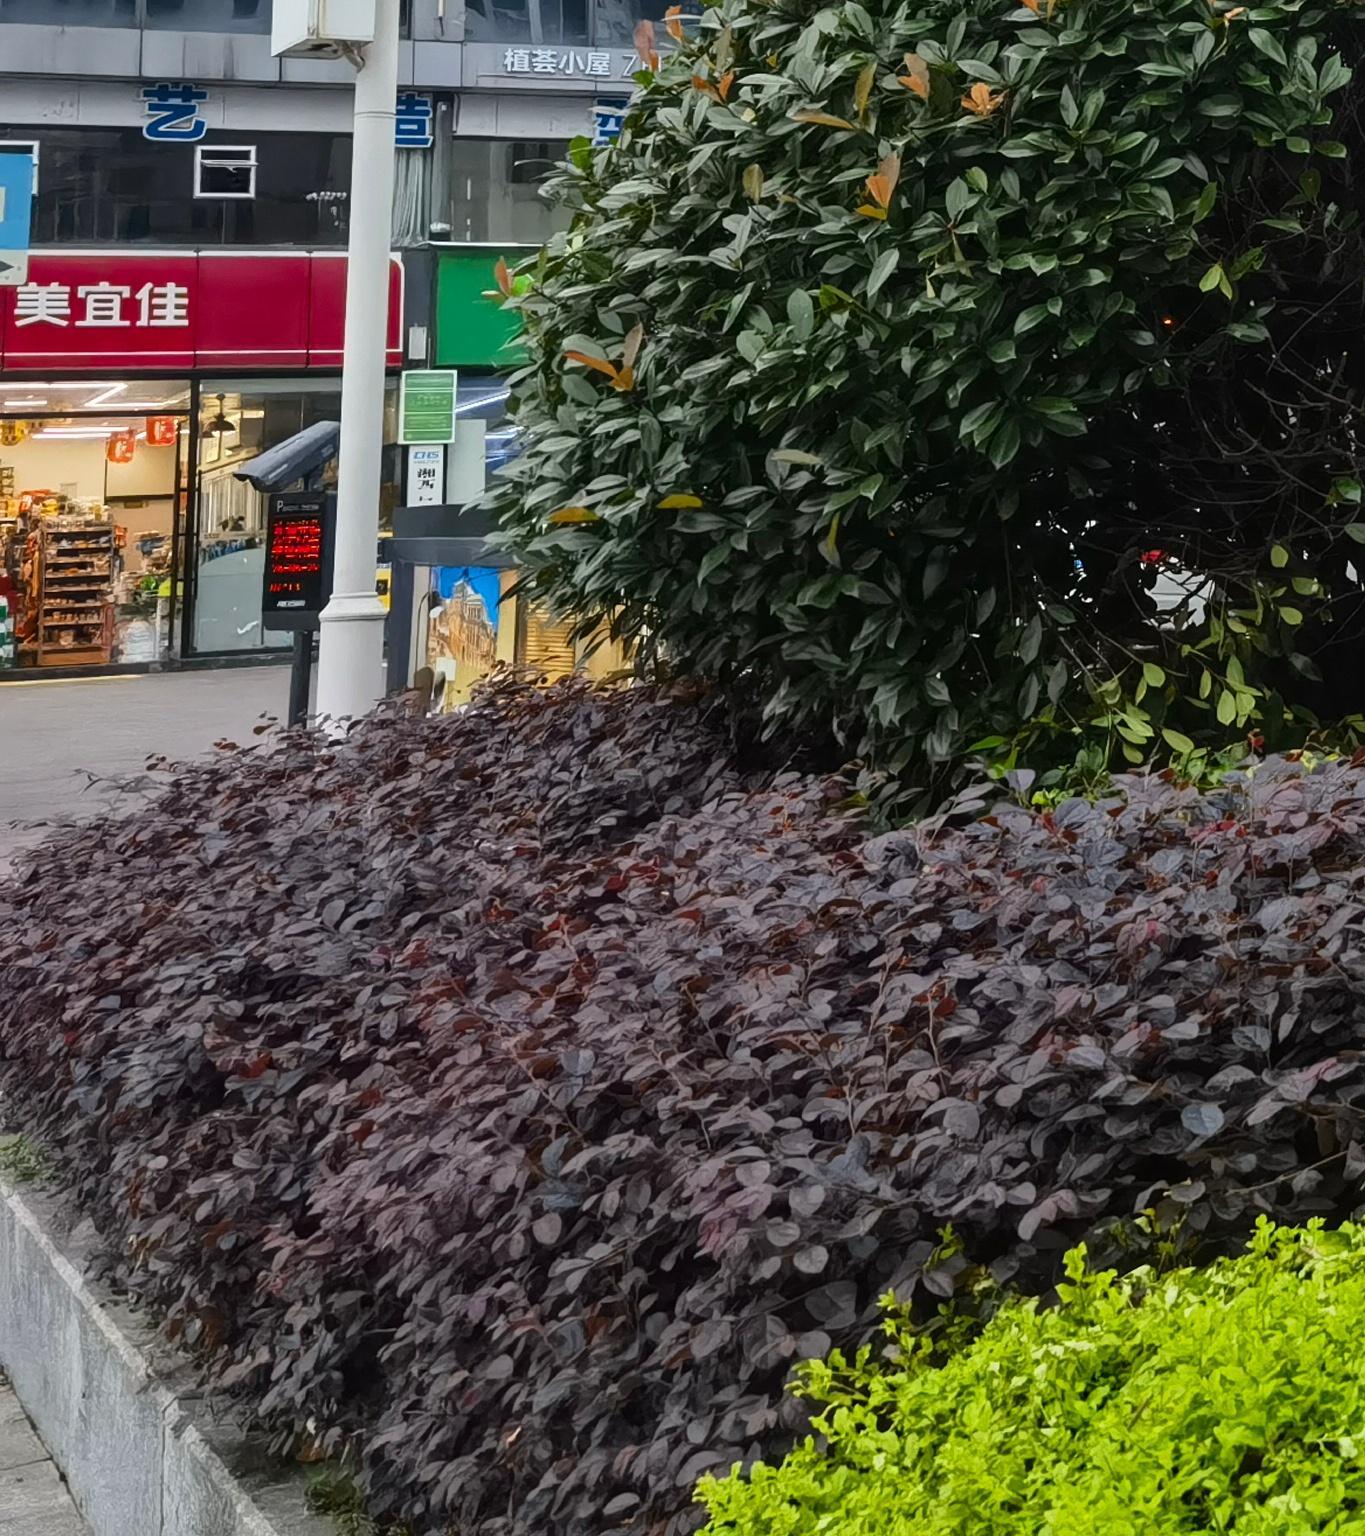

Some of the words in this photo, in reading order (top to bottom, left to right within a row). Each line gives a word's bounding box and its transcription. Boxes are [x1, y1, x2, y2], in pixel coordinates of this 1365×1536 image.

[503, 47, 611, 76] 植荟小屋
[13, 281, 190, 328] 美宜佳
